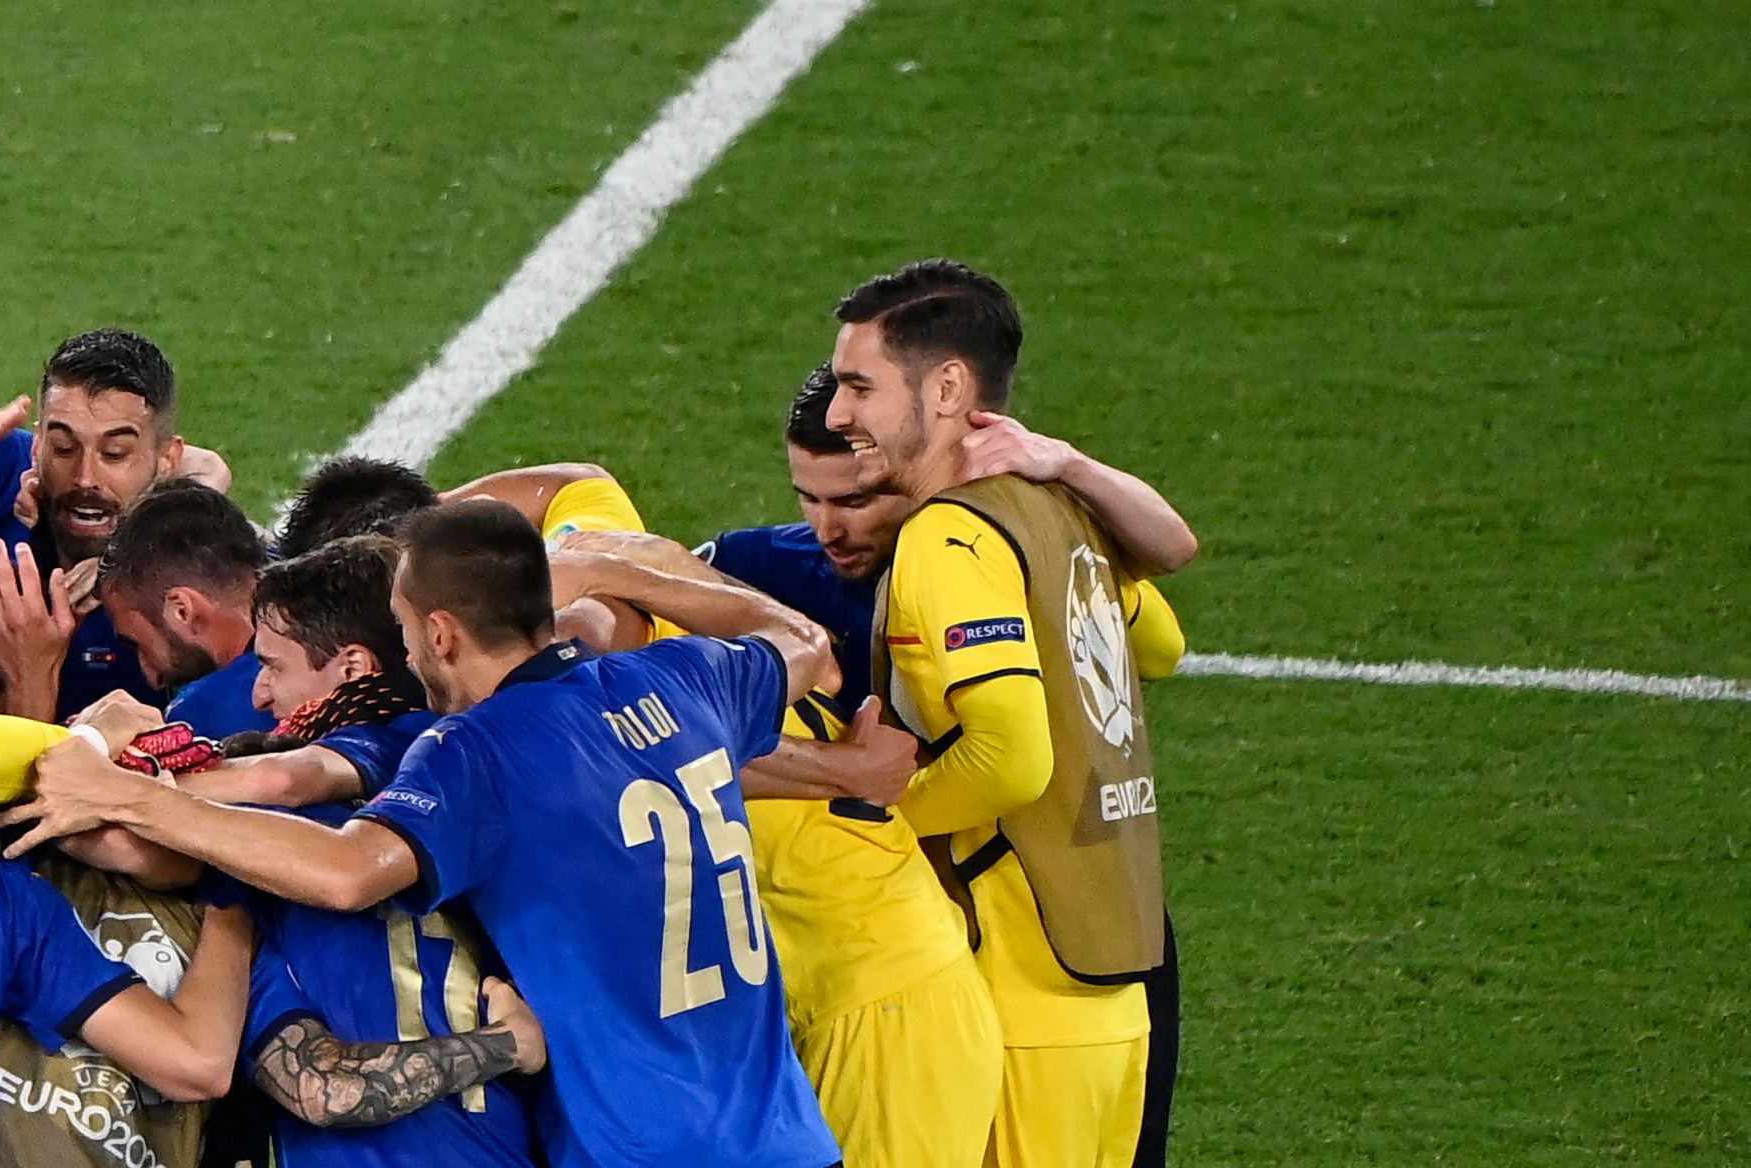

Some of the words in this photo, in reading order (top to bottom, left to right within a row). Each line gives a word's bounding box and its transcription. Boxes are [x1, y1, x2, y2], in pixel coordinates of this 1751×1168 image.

[966, 623, 1024, 640] RESPECT
[384, 790, 438, 811] RESPECT
[618, 746, 769, 1020] 25
[75, 1068, 136, 1115] UEFA
